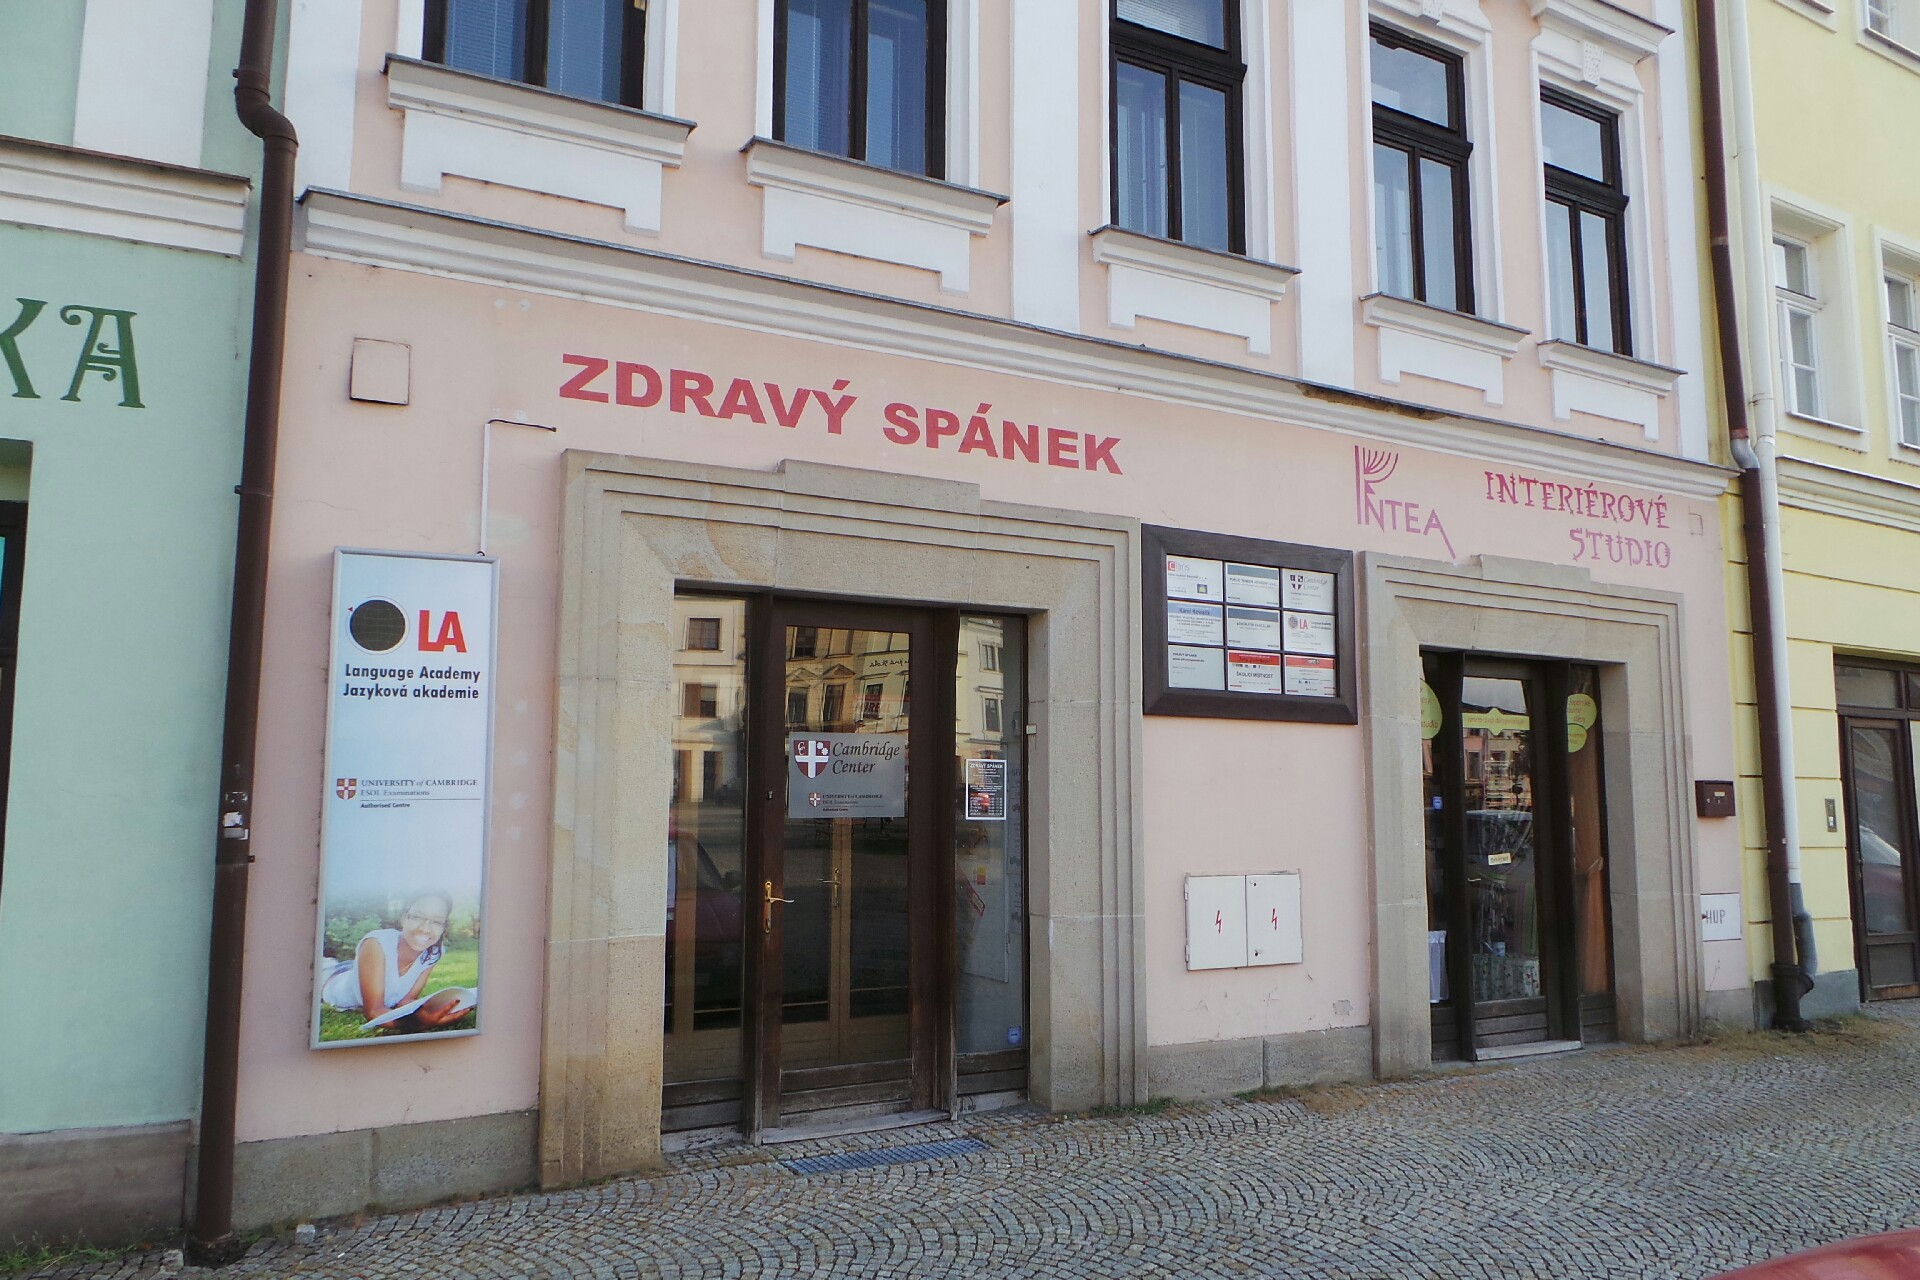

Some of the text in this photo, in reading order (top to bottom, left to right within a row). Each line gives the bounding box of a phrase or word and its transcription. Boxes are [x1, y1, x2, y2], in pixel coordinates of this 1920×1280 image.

[558, 353, 1123, 475] ZDRAVÝ SPÁNEK
[1484, 471, 1670, 529] INTERIÉROVÉ
[1569, 527, 1672, 569] STUDIO
[418, 609, 467, 653] LA
[1299, 618, 1308, 629] LA
[345, 664, 481, 684] Language Academy
[343, 683, 479, 700] Jazyková akademie
[832, 740, 900, 760] Cambridge
[832, 760, 876, 774] Center
[361, 779, 416, 787] UNIVERSITY
[425, 779, 478, 787] CAMBRIDGE
[1705, 910, 1726, 924] HUP
